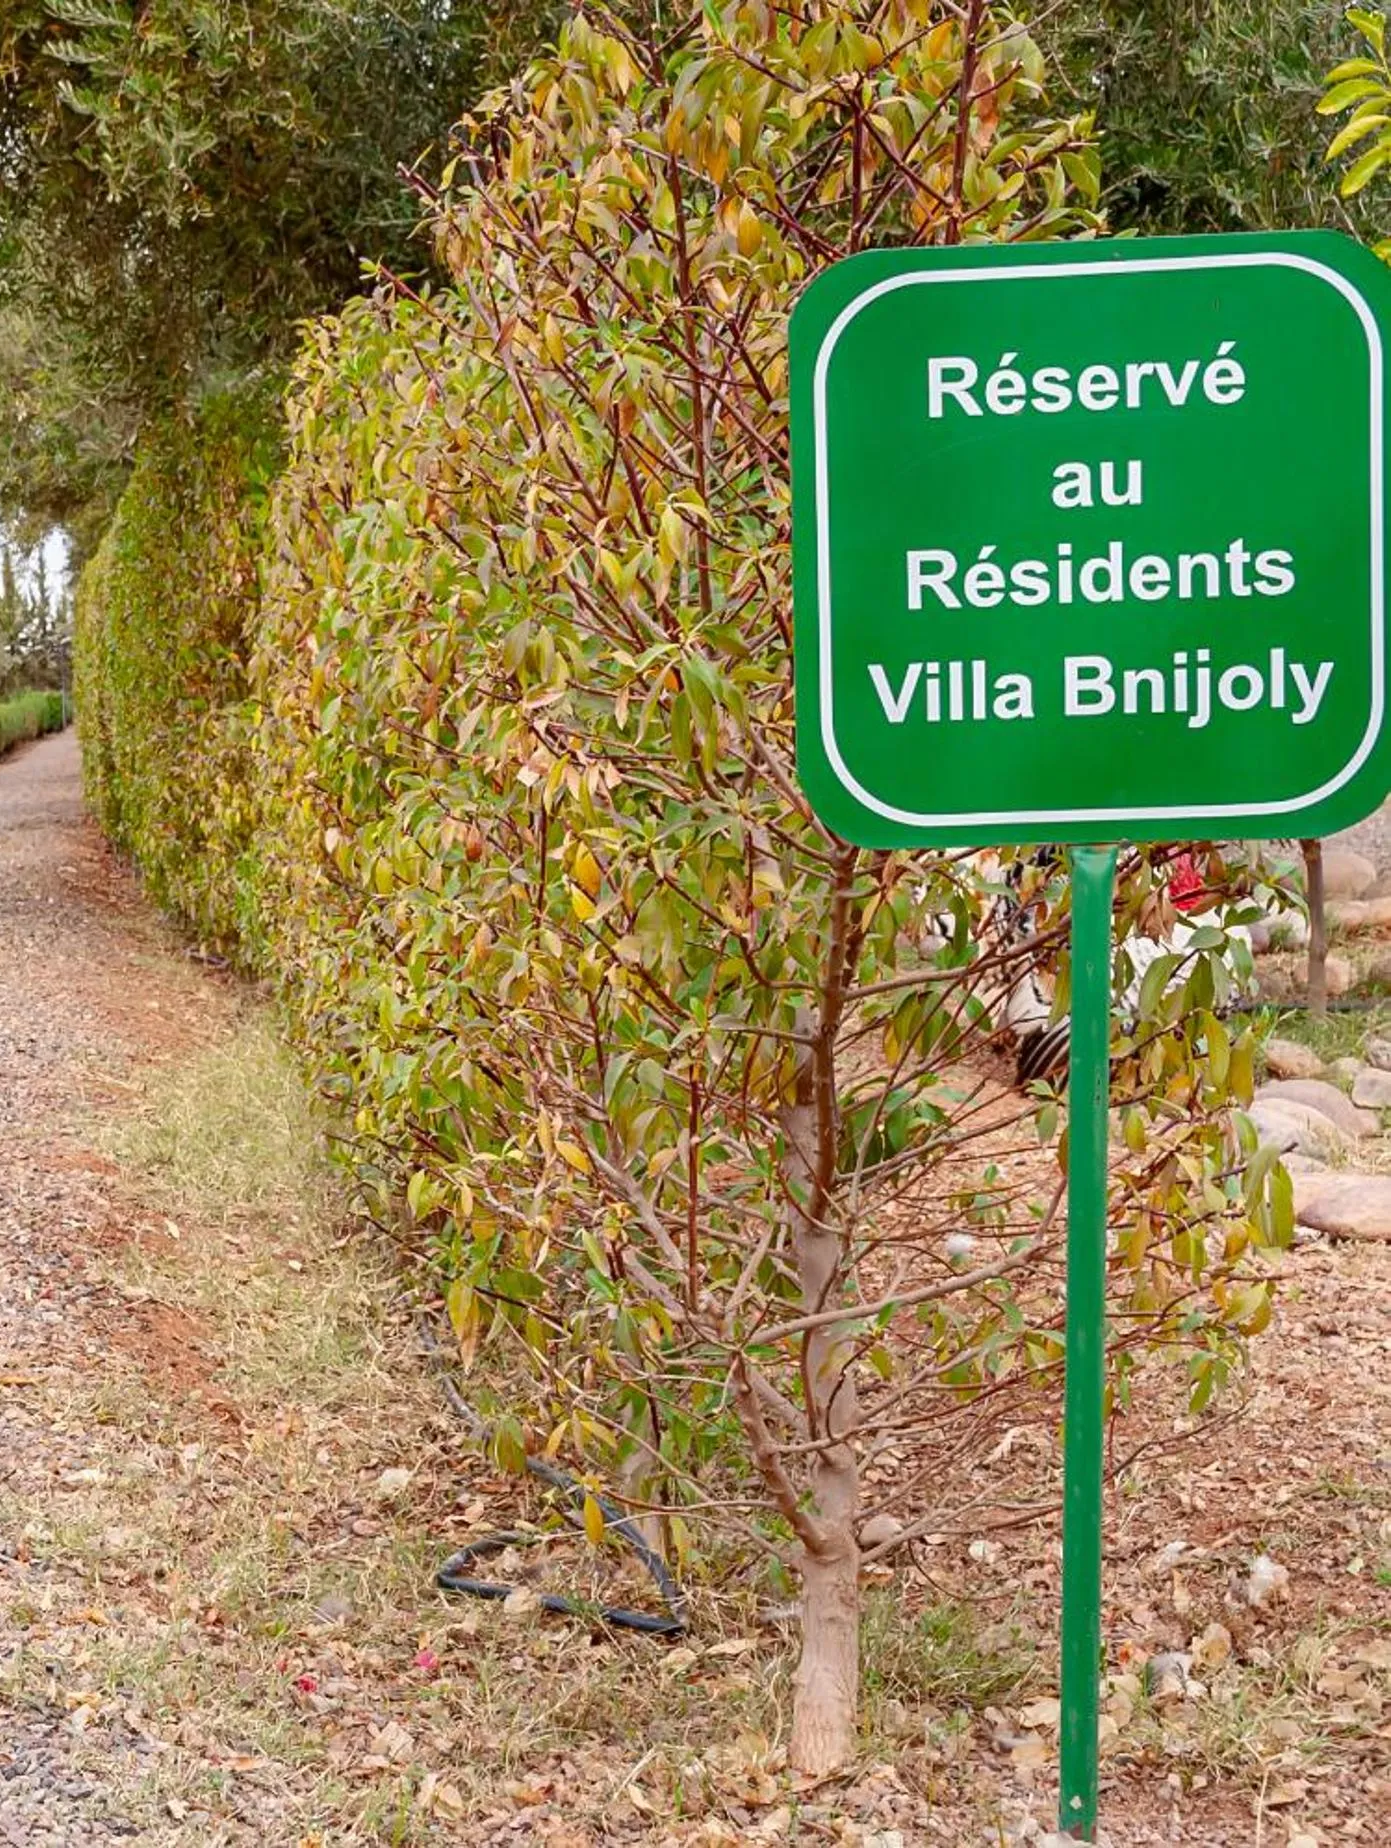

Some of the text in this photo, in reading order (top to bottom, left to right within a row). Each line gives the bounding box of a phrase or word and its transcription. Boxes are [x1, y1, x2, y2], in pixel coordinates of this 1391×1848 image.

[928, 341, 1245, 418] Réservé
[1052, 460, 1142, 508] au
[906, 538, 1295, 610] Résidents
[867, 647, 1334, 728] Villa Bnijoly
